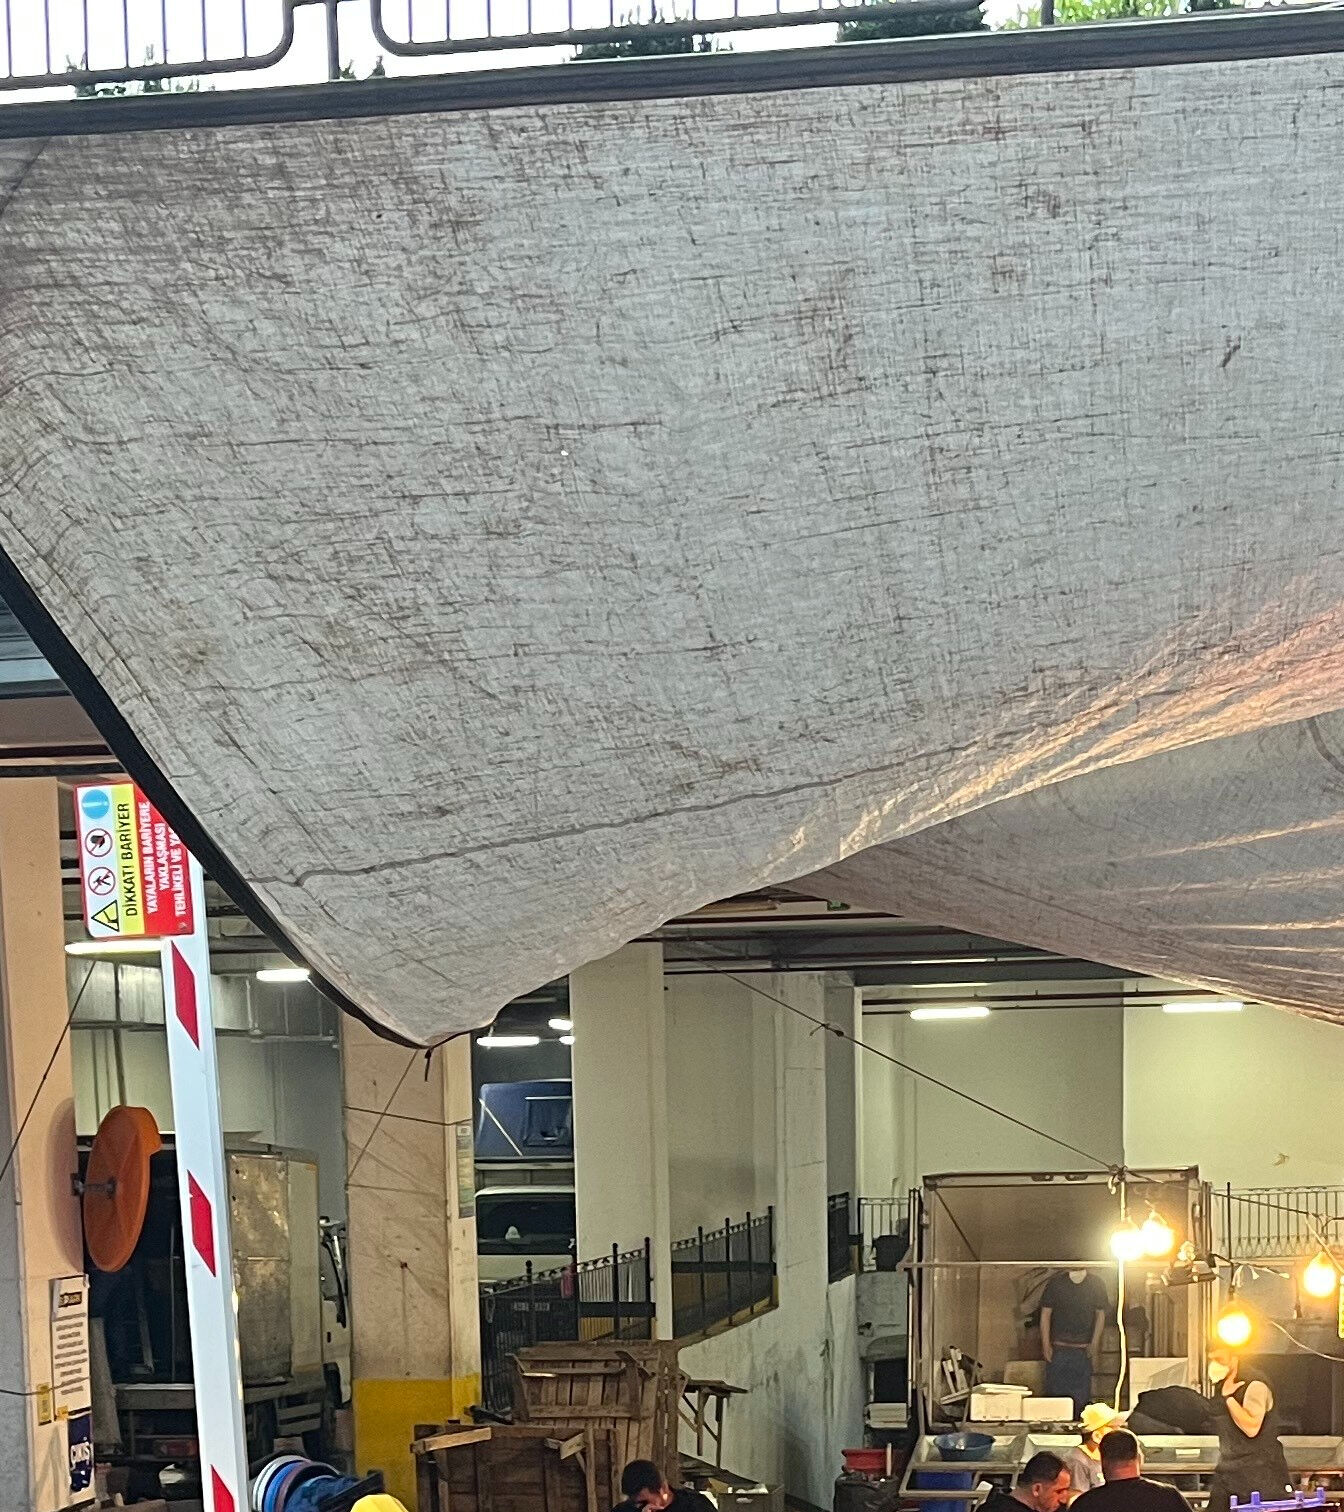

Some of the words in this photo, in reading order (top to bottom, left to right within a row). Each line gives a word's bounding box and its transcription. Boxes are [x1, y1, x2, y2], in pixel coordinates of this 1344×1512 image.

[116, 802, 133, 862] BARİYER
[170, 848, 182, 863] VE
[143, 856, 158, 914] YAYALARIN
[170, 864, 186, 916] TEHLİKELİ
